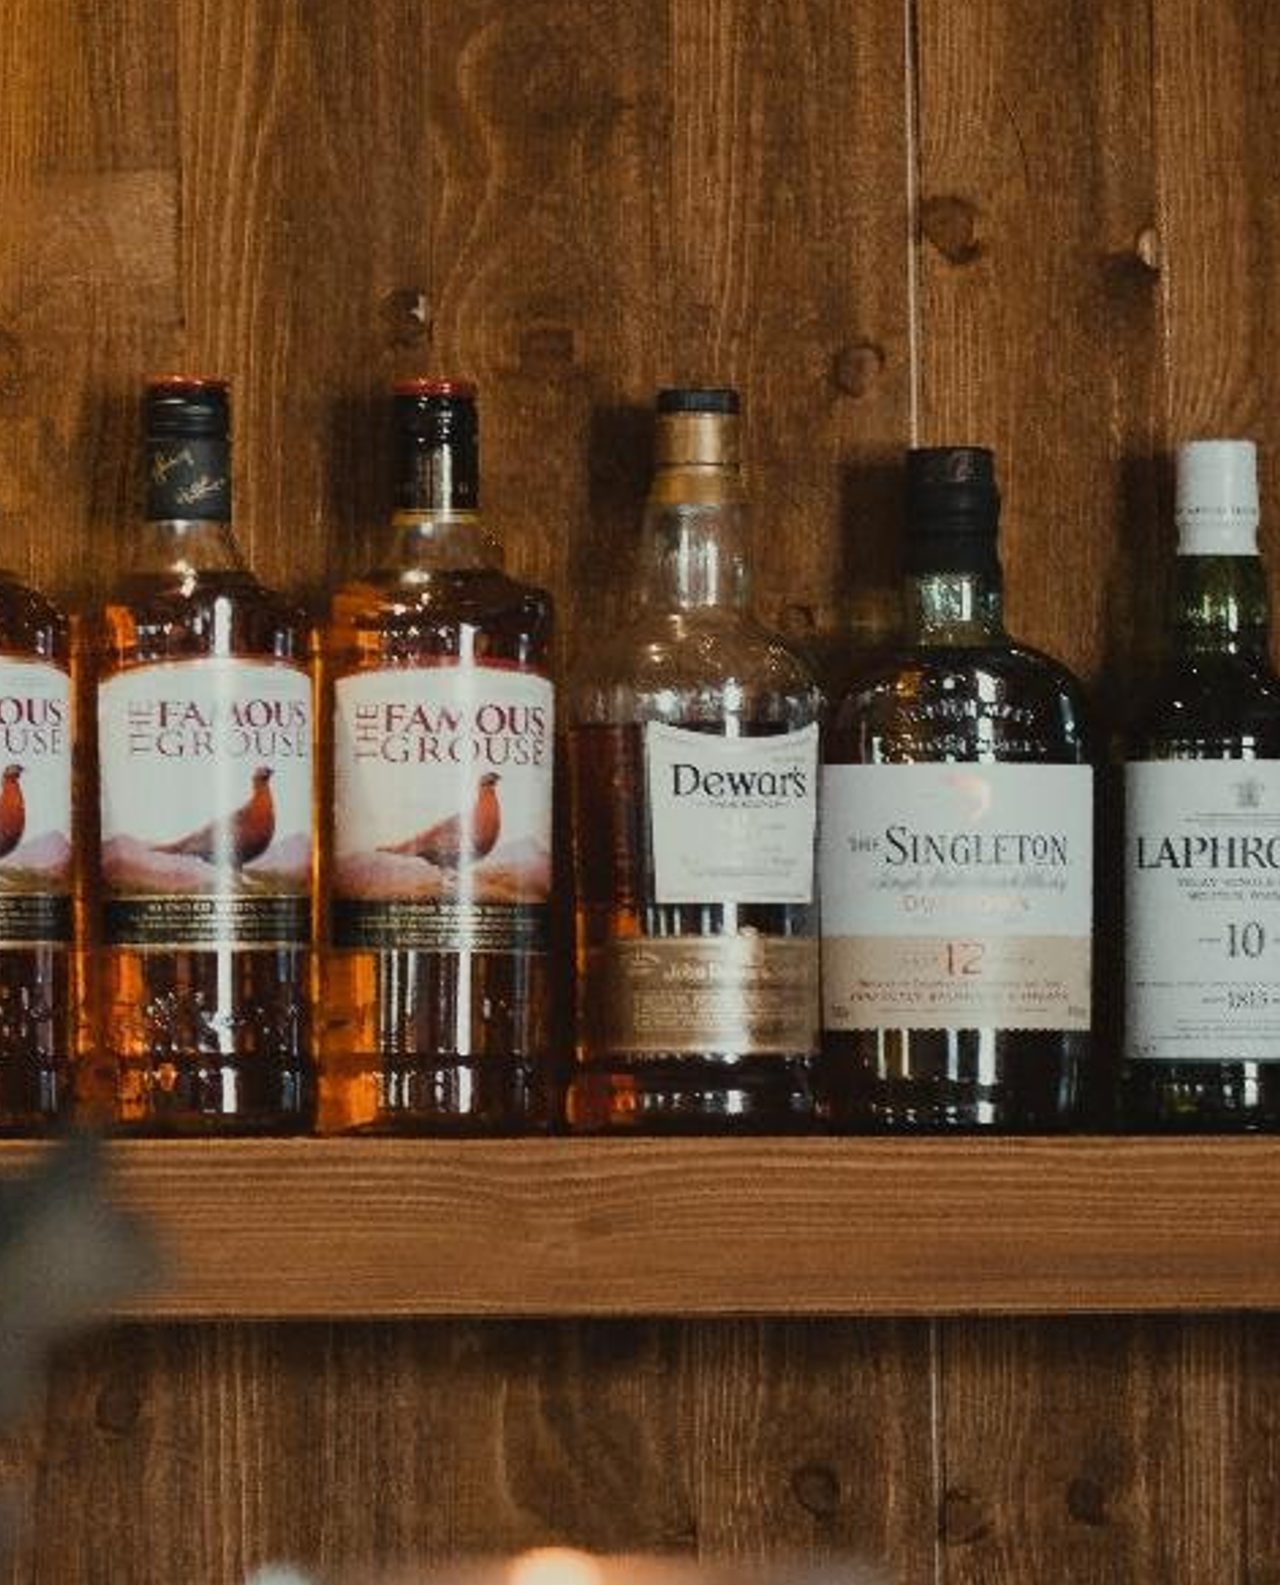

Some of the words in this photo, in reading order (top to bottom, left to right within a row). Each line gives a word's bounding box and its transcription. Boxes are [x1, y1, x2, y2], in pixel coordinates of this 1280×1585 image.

[379, 736, 546, 766] GROUSE
[670, 762, 807, 799] Dewar's
[884, 824, 1069, 867] SINGLETON
[1225, 919, 1266, 960] 10
[945, 942, 985, 976] 12
